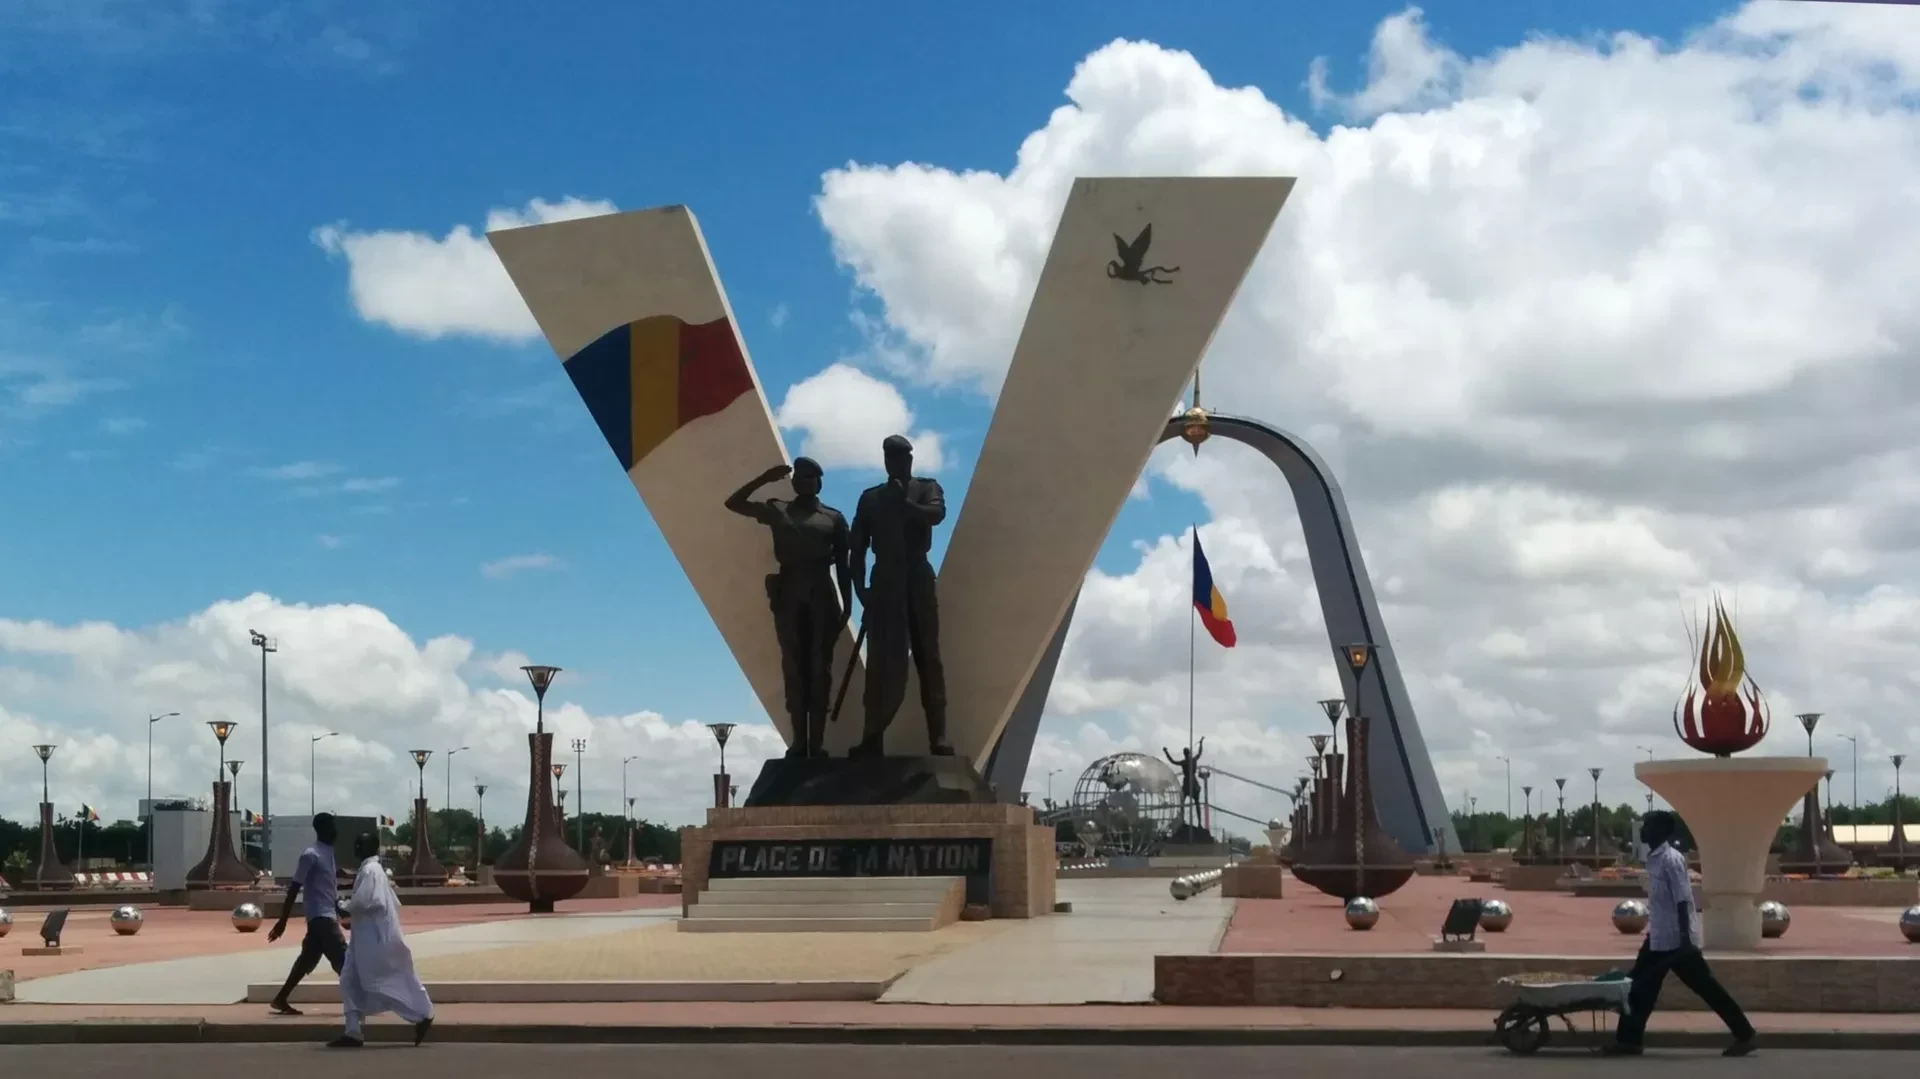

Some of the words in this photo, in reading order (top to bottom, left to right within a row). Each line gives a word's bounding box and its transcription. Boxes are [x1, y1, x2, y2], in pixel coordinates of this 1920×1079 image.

[721, 845, 803, 872] PLACE
[808, 845, 842, 872] DE
[855, 845, 879, 876] LA
[887, 844, 980, 876] NATION
